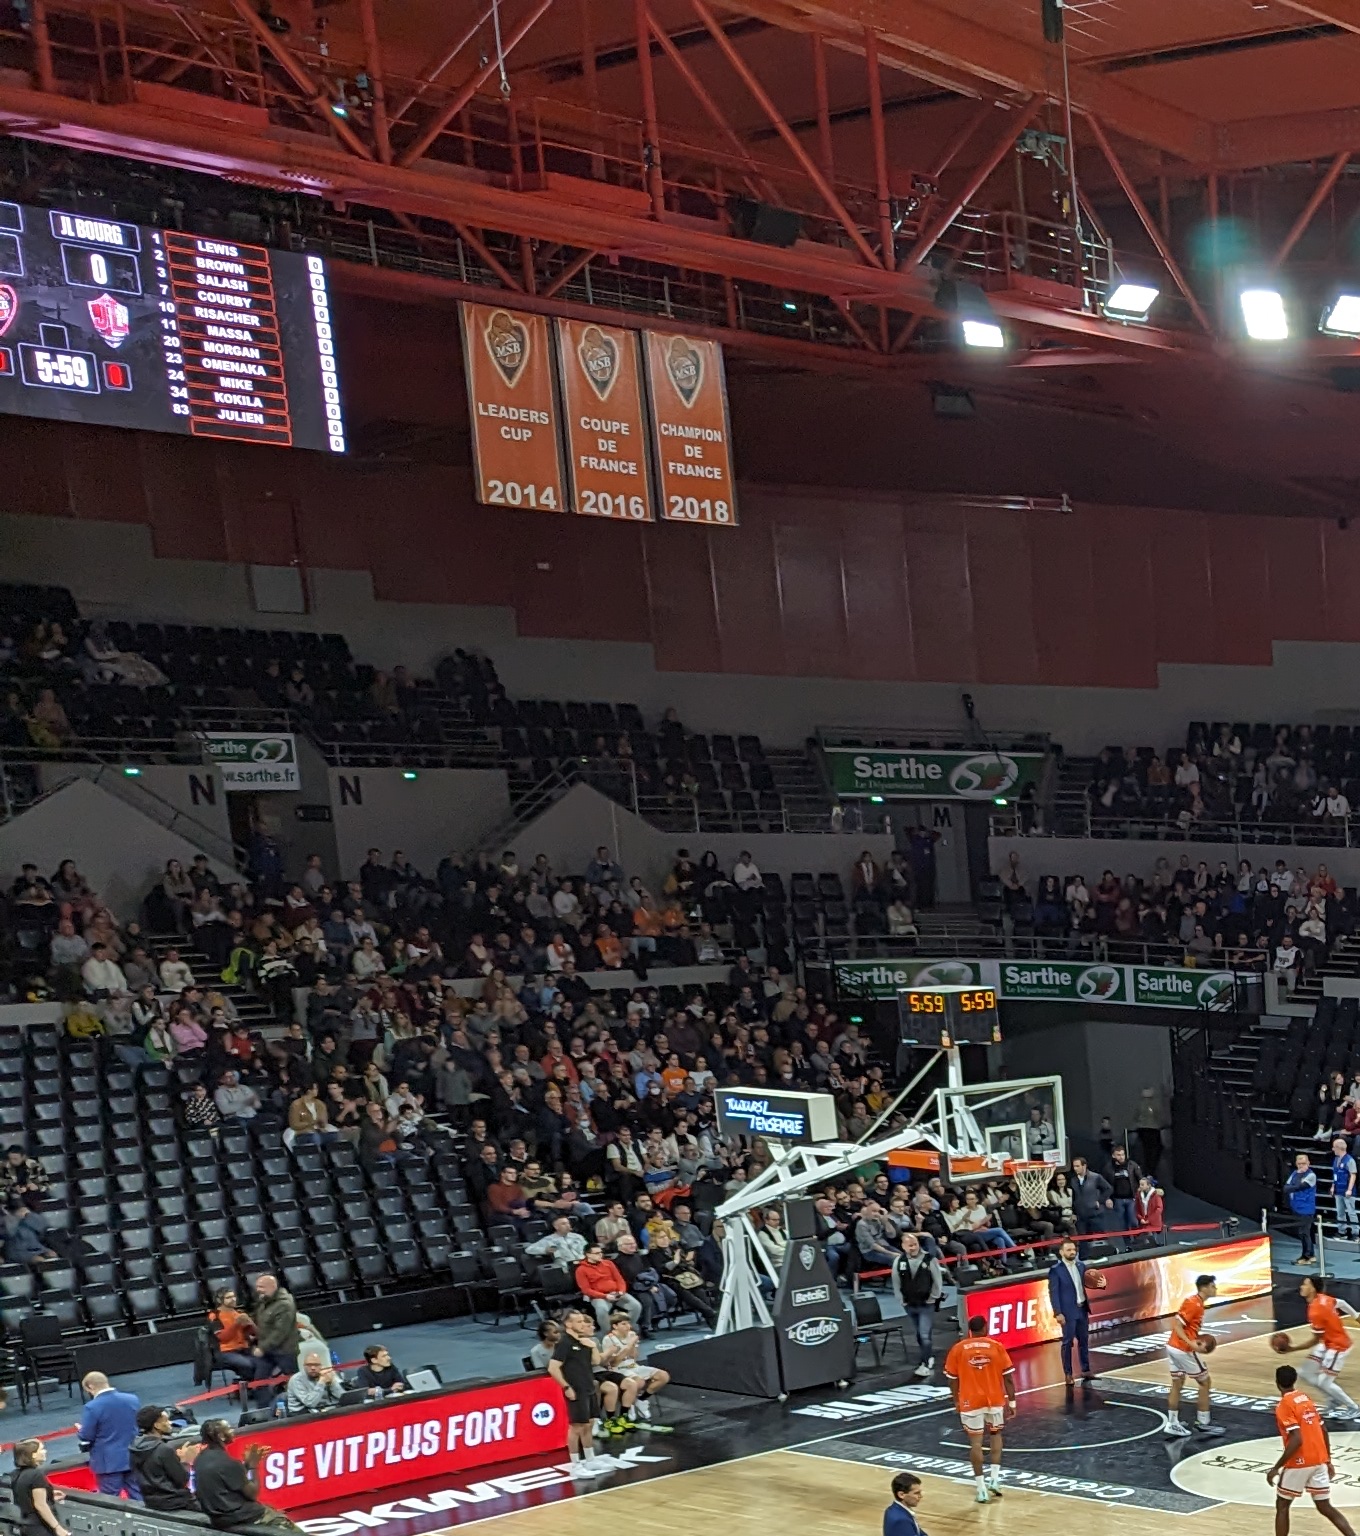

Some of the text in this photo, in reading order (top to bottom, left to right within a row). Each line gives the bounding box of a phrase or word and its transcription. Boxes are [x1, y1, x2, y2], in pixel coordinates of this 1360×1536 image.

[61, 216, 124, 245] JL BOURG
[152, 233, 161, 244] 1
[197, 240, 239, 256] LEWIS
[90, 254, 109, 285] 0
[154, 250, 164, 261] 2
[196, 257, 244, 275] BROWN
[157, 267, 166, 278] 3
[197, 274, 248, 292] SALASH
[159, 284, 168, 295] 7
[198, 291, 251, 308] COURBY
[159, 301, 176, 313] 10
[195, 306, 260, 327] RISACHER
[161, 319, 177, 331] 11
[207, 325, 253, 342] MASSA
[163, 336, 180, 348] 20
[203, 341, 260, 359] MORGAN
[34, 350, 90, 388] 5:59
[166, 353, 183, 364] 23
[202, 358, 266, 377] OMENAKA
[109, 366, 123, 388] 0
[168, 369, 185, 381] 24
[220, 377, 253, 391] MIKE
[170, 386, 188, 398] 34
[214, 392, 263, 409] KOKILA
[172, 404, 190, 416] 83
[218, 408, 264, 424] JULIEN
[478, 402, 549, 425] LEADERS
[500, 426, 532, 442] CUP
[580, 416, 630, 435] COUPE
[661, 422, 722, 443] CHAMPION
[598, 438, 617, 453] DE
[685, 445, 702, 459] DE
[580, 456, 638, 475] FRANCE
[668, 461, 722, 480] FRANCE
[487, 480, 557, 510] 2014
[581, 490, 645, 519] 2016
[669, 496, 729, 522] 2018
[853, 756, 942, 780] Sarthe
[190, 774, 214, 806] N
[339, 775, 362, 805] N
[933, 807, 951, 828] M
[1005, 966, 1072, 986] Sarthe
[1138, 972, 1192, 993] Sarthe
[909, 994, 944, 1013] 5:59
[961, 991, 994, 1011] 5:59
[755, 1116, 804, 1135] ENSEMBLE
[795, 1289, 828, 1306] Betclic
[989, 1298, 1038, 1335] ET LE
[796, 1320, 839, 1341] Gaulois
[264, 1451, 306, 1490] SE
[314, 1436, 365, 1480] VIT
[364, 1420, 440, 1469] PLUS
[446, 1403, 522, 1452] FORT
